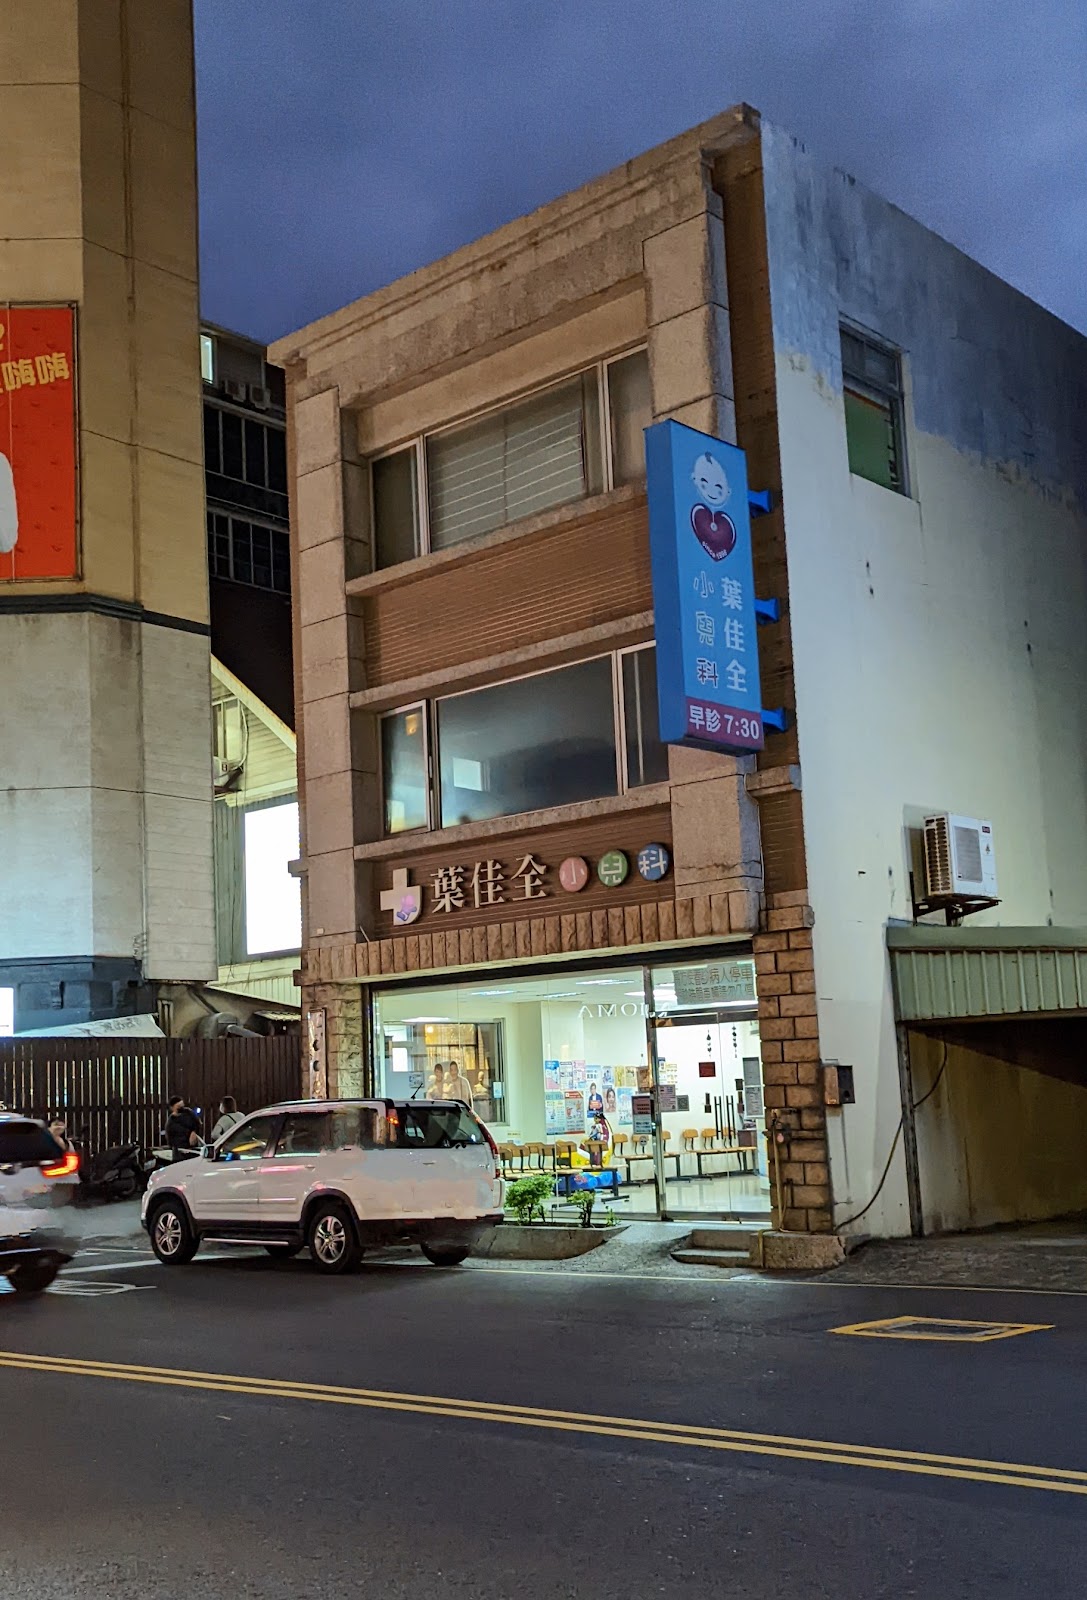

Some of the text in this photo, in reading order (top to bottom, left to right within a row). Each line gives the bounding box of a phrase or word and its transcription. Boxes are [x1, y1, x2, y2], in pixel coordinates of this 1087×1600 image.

[0, 352, 70, 394] 嗨嗨
[693, 570, 720, 690] 小兒科
[720, 577, 747, 692] 葉佳全
[689, 704, 759, 740] 早診 7:30
